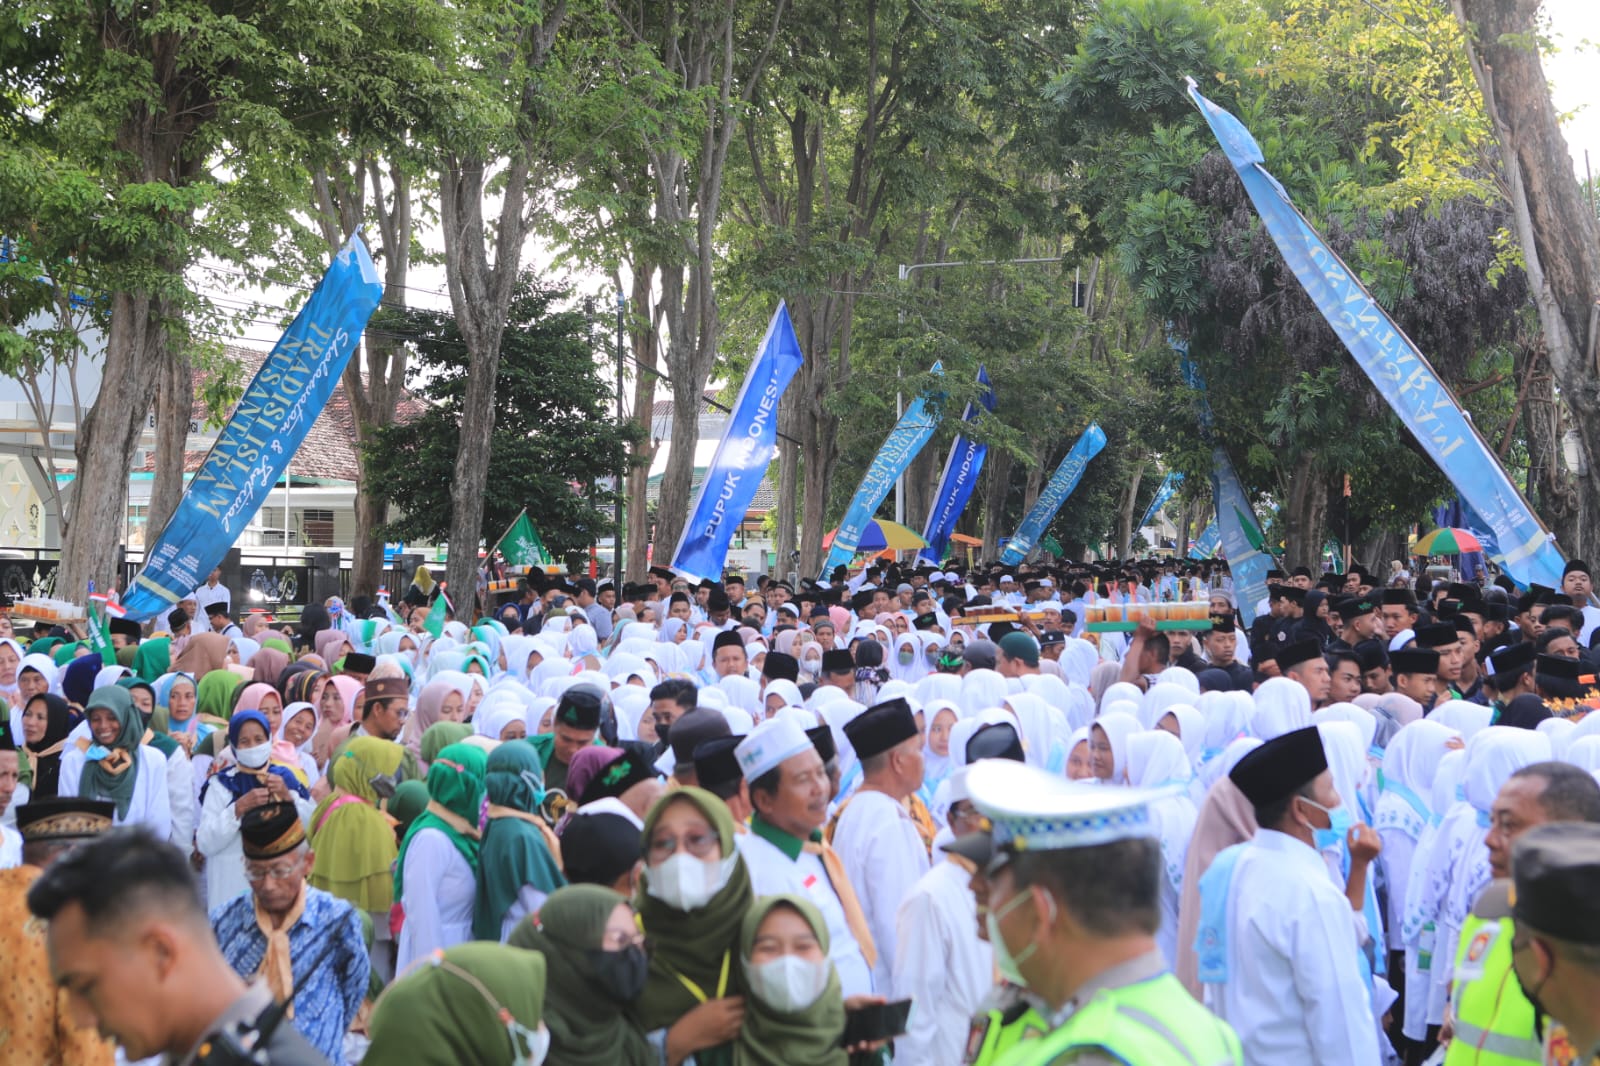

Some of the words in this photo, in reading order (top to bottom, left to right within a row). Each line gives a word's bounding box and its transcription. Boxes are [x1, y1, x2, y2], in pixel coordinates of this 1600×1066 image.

[196, 334, 304, 481] NUSANTARA
[255, 322, 334, 432] TRADISI
[279, 327, 349, 437] Sholawatan
[196, 432, 267, 519] ISLAM
[221, 455, 274, 534] Festival
[271, 439, 283, 454] &
[704, 471, 742, 539] PUPUK
[735, 368, 781, 471] INDONESI
[936, 486, 960, 534] PUPUK
[957, 440, 977, 485] INDON
